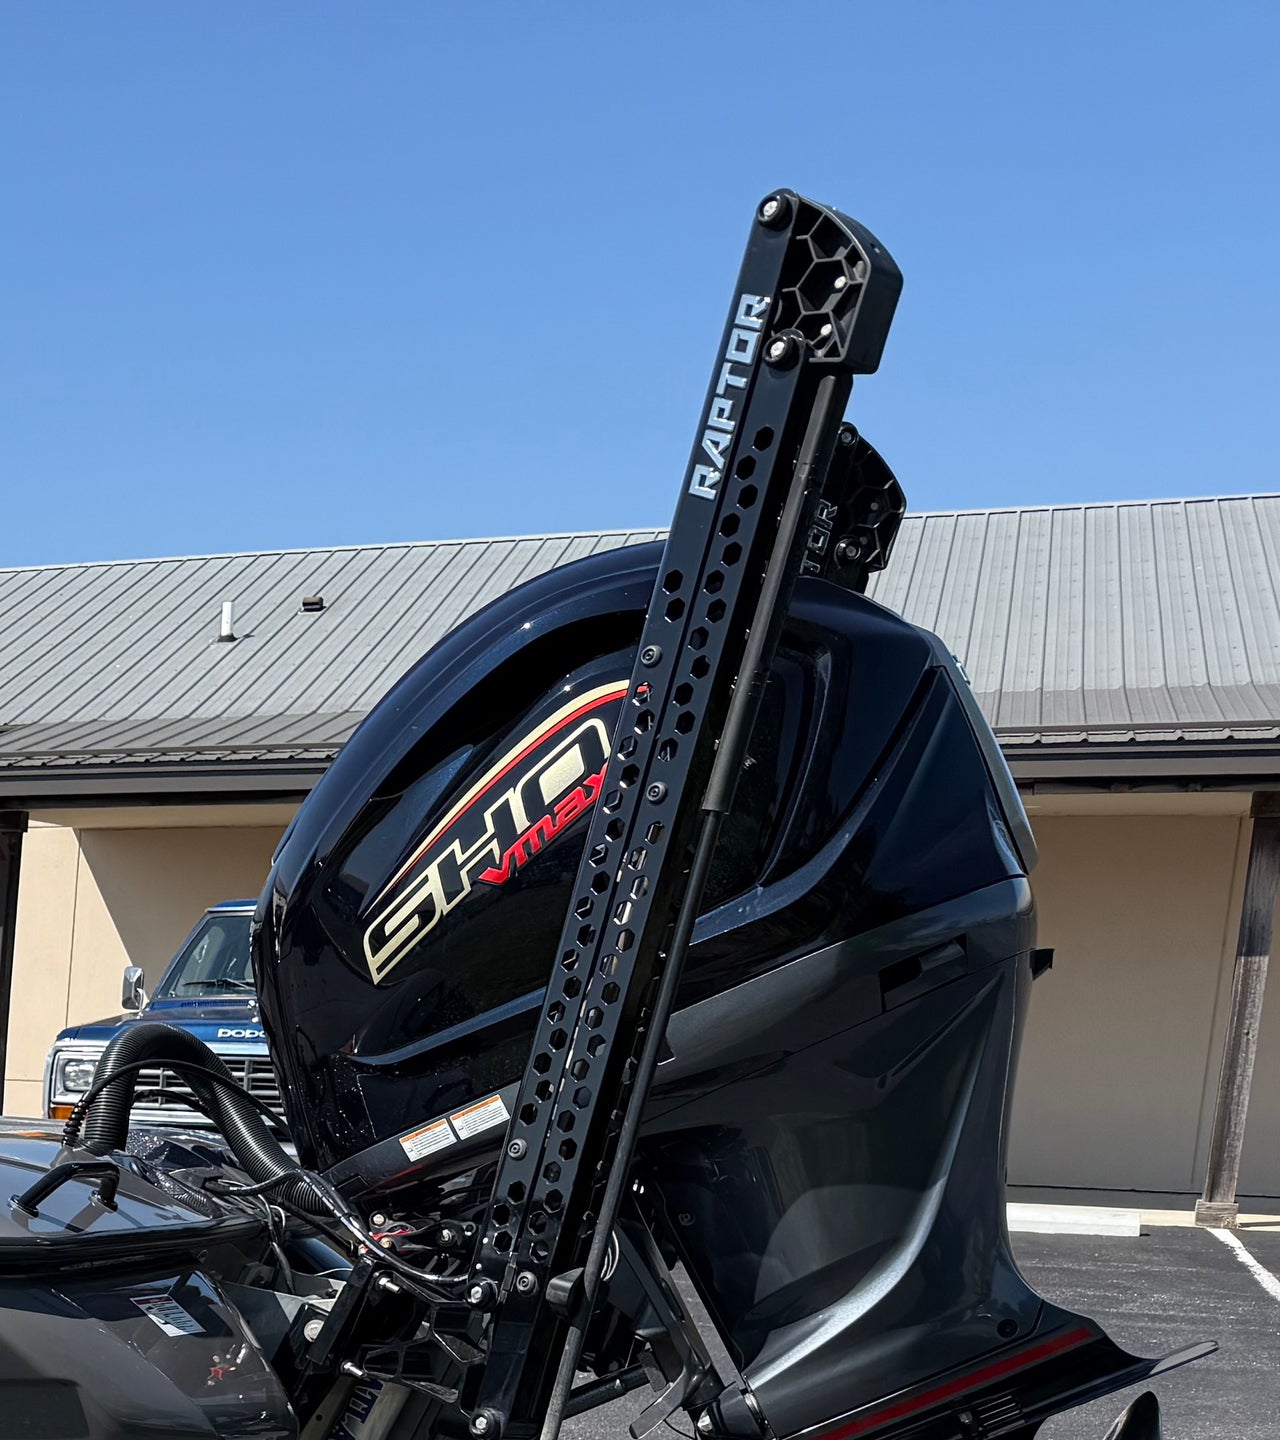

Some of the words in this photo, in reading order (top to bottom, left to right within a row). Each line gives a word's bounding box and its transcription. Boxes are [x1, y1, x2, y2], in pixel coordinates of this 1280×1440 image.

[689, 293, 771, 501] RAPTOR
[799, 499, 839, 575] TOR
[363, 717, 612, 986] SHO
[217, 1028, 266, 1038] DOD
